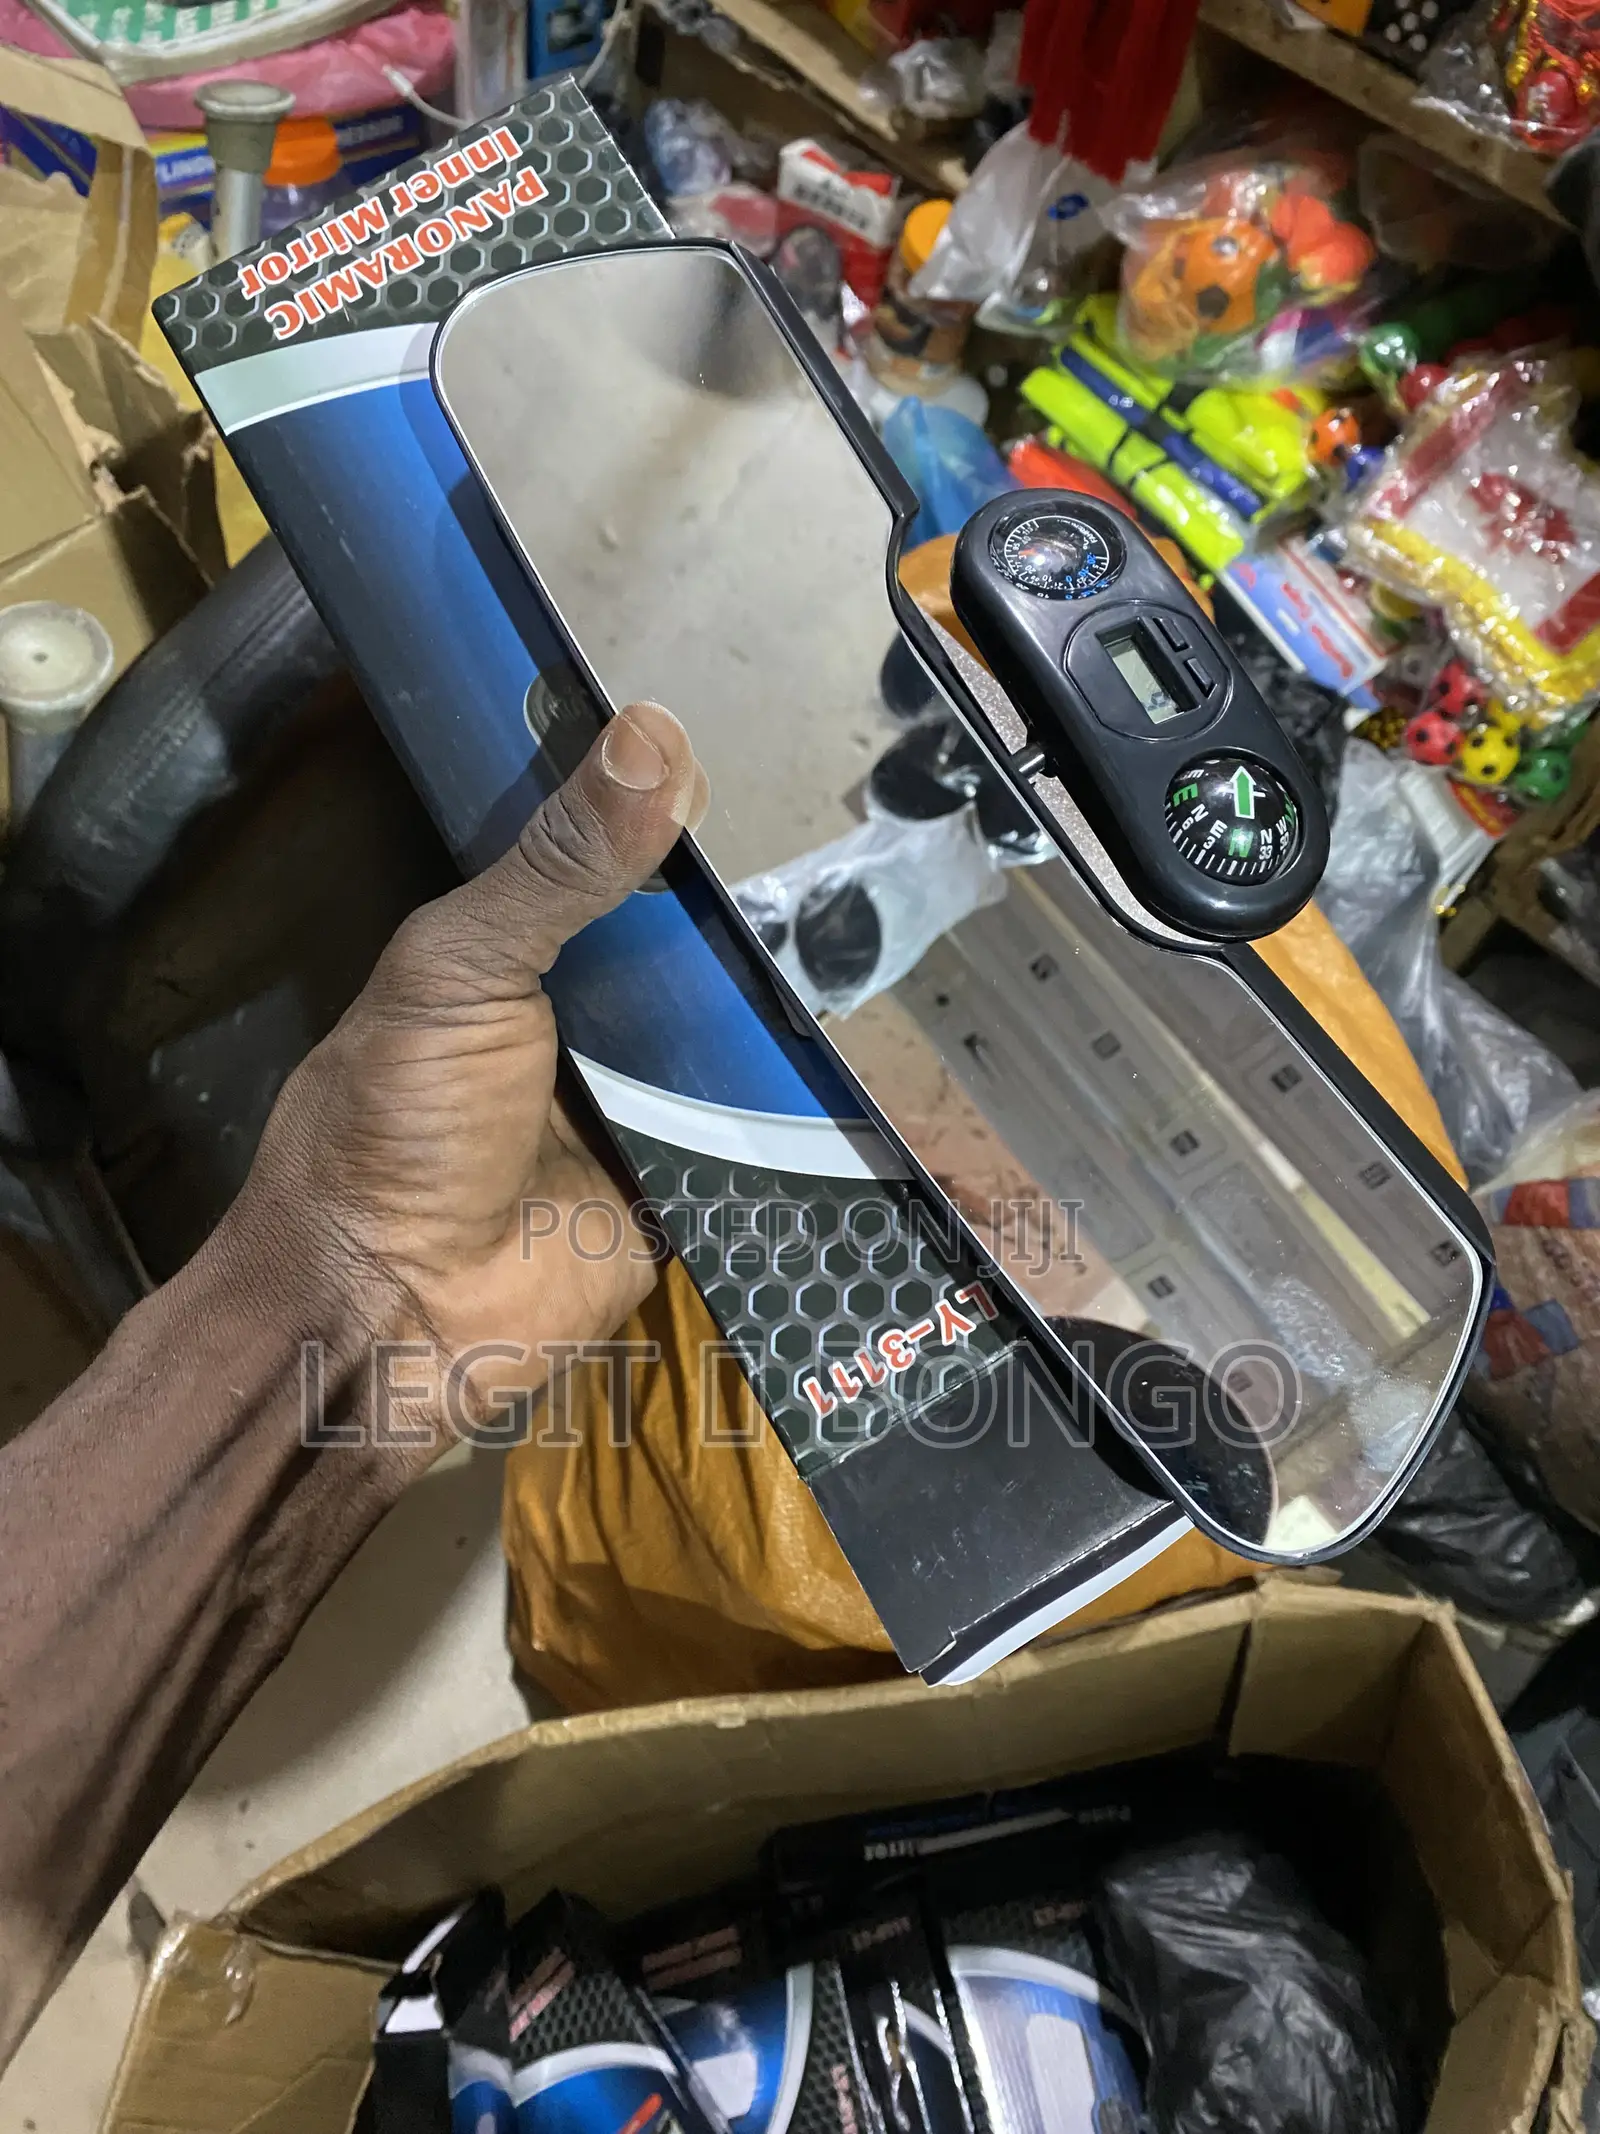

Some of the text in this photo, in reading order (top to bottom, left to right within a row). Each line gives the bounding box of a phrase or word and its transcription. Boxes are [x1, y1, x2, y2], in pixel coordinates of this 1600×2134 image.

[238, 126, 524, 301] Inner Mirror
[263, 165, 549, 340] PANORAMIC
[801, 1281, 1001, 1418] LY-3111
